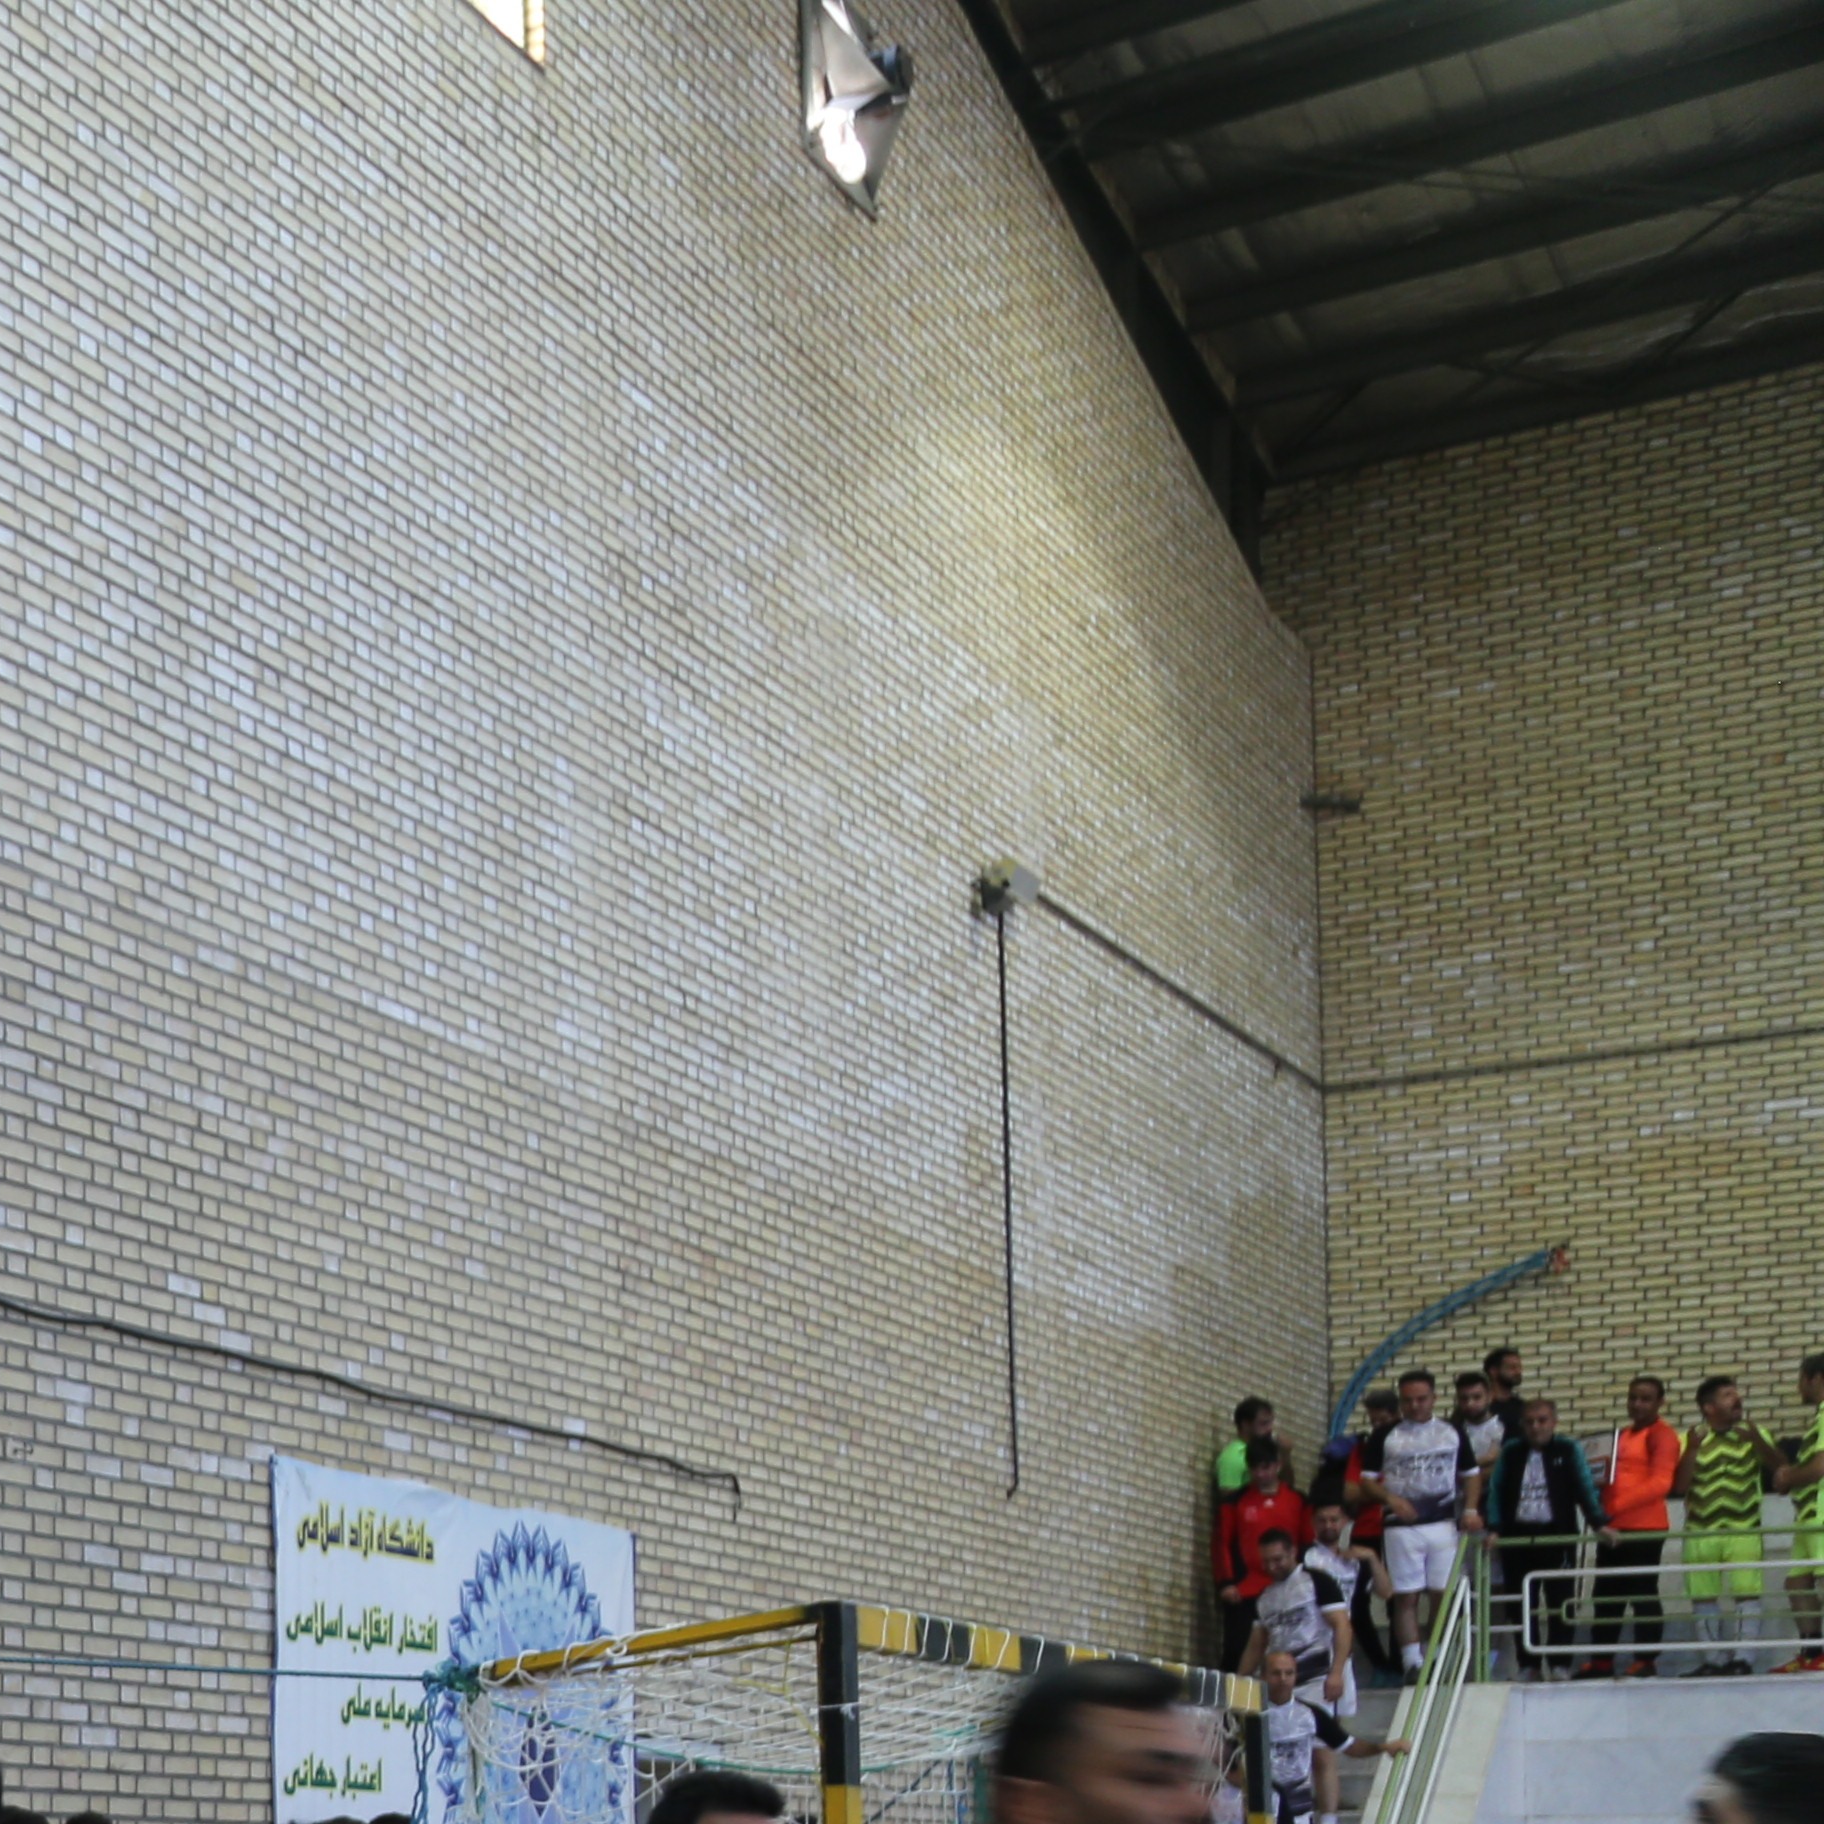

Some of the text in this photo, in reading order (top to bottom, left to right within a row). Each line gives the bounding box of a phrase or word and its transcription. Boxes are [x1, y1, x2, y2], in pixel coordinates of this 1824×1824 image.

[297, 1499, 435, 1563] دانشگاه آزاد اسلامی
[286, 1600, 439, 1655] افتخار انقلاب اسلامی
[341, 1682, 372, 1725] ملی
[284, 1752, 383, 1800] اعتبار جهانی
